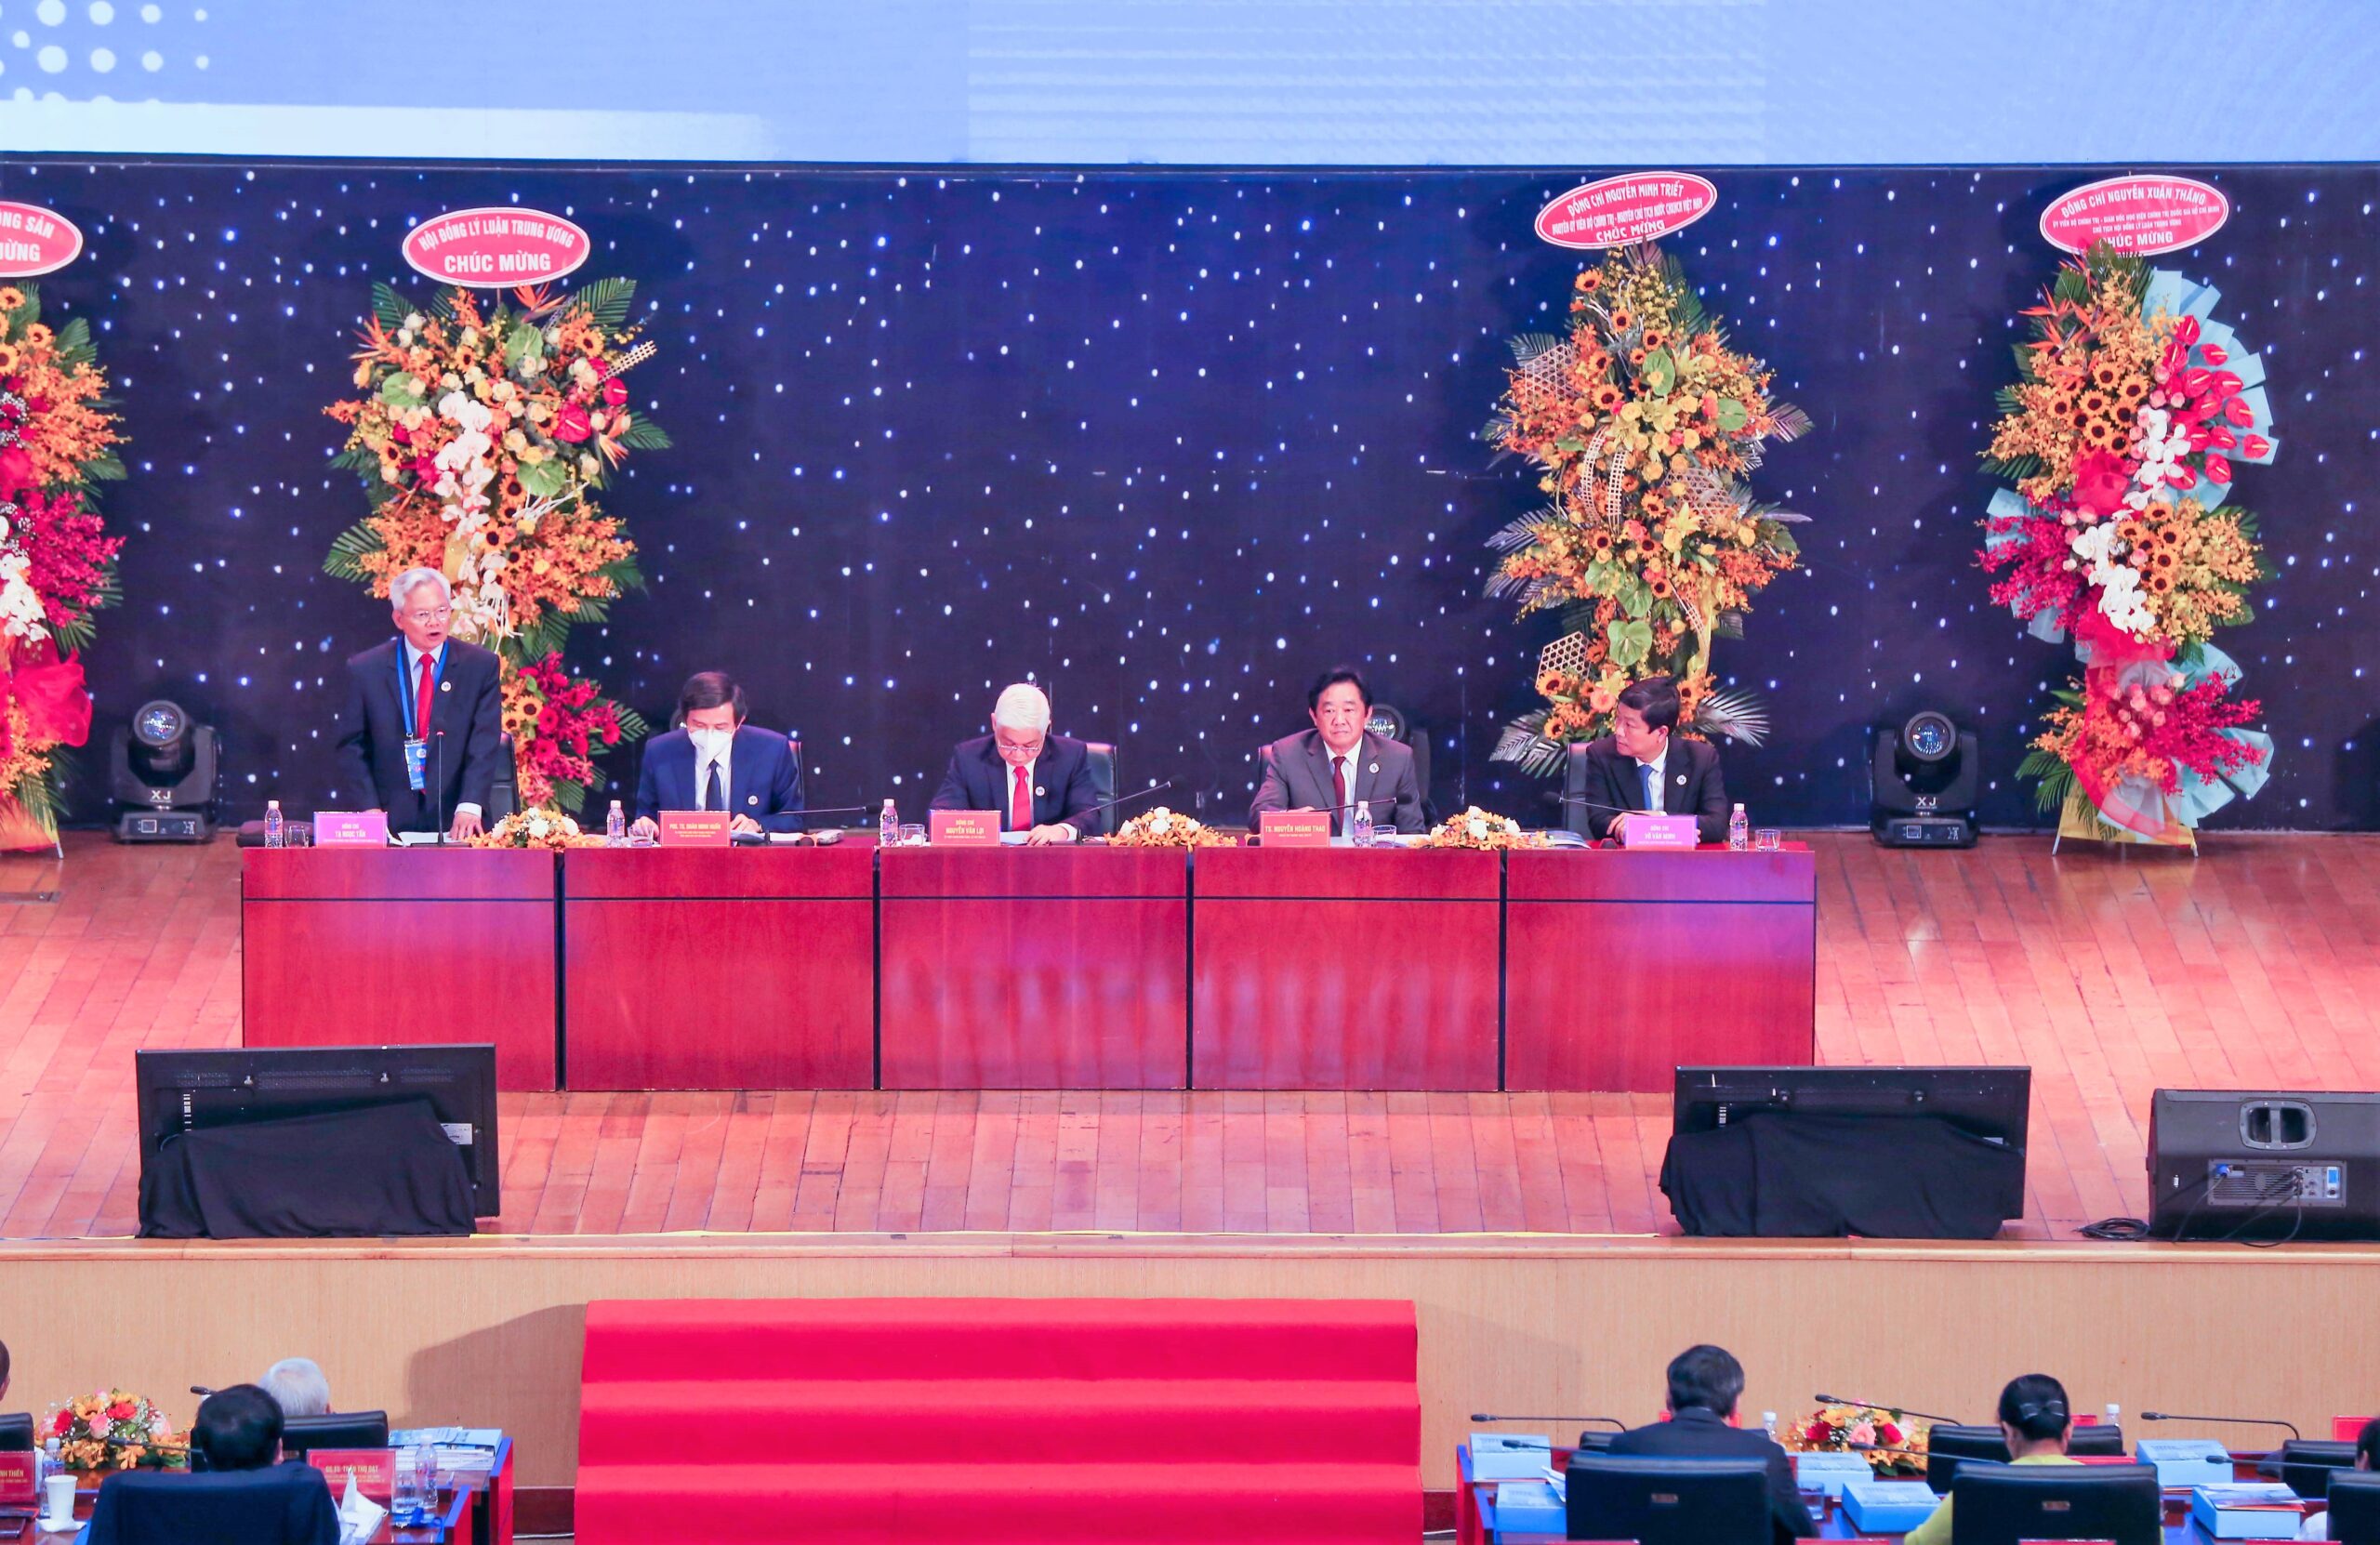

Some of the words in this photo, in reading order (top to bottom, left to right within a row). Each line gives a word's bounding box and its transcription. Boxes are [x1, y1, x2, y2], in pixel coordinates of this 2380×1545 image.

[1567, 196, 1591, 217] ĐỒNG
[1590, 189, 1605, 207] CHÍ
[1605, 180, 1637, 204] NGUYỄN
[1637, 183, 1659, 197] MINH
[1659, 178, 1684, 197] TRIẾT
[2061, 200, 2087, 218] ĐỒNG
[2088, 191, 2106, 207] CHÍ
[2108, 184, 2144, 204] NGUYỄN
[2147, 184, 2173, 199] XUÂN
[2175, 188, 2206, 205] THẮNG
[0, 208, 22, 230] NG
[25, 216, 55, 239] SẢN
[417, 230, 439, 251] HỘI
[438, 221, 468, 243] ĐỒNG
[469, 217, 481, 236] LÝ
[483, 216, 509, 238] LUẬN
[511, 219, 545, 238] TRUNG
[546, 225, 575, 248] ƯƠNG
[1595, 226, 1627, 242] CHÚC
[1630, 219, 1665, 236] MỪNG
[0, 239, 40, 262] ỪNG
[2099, 233, 2133, 247] HÚC
[2136, 231, 2174, 245] MỪNG
[444, 251, 494, 273] CHÚC
[498, 250, 550, 271] MỪNG
